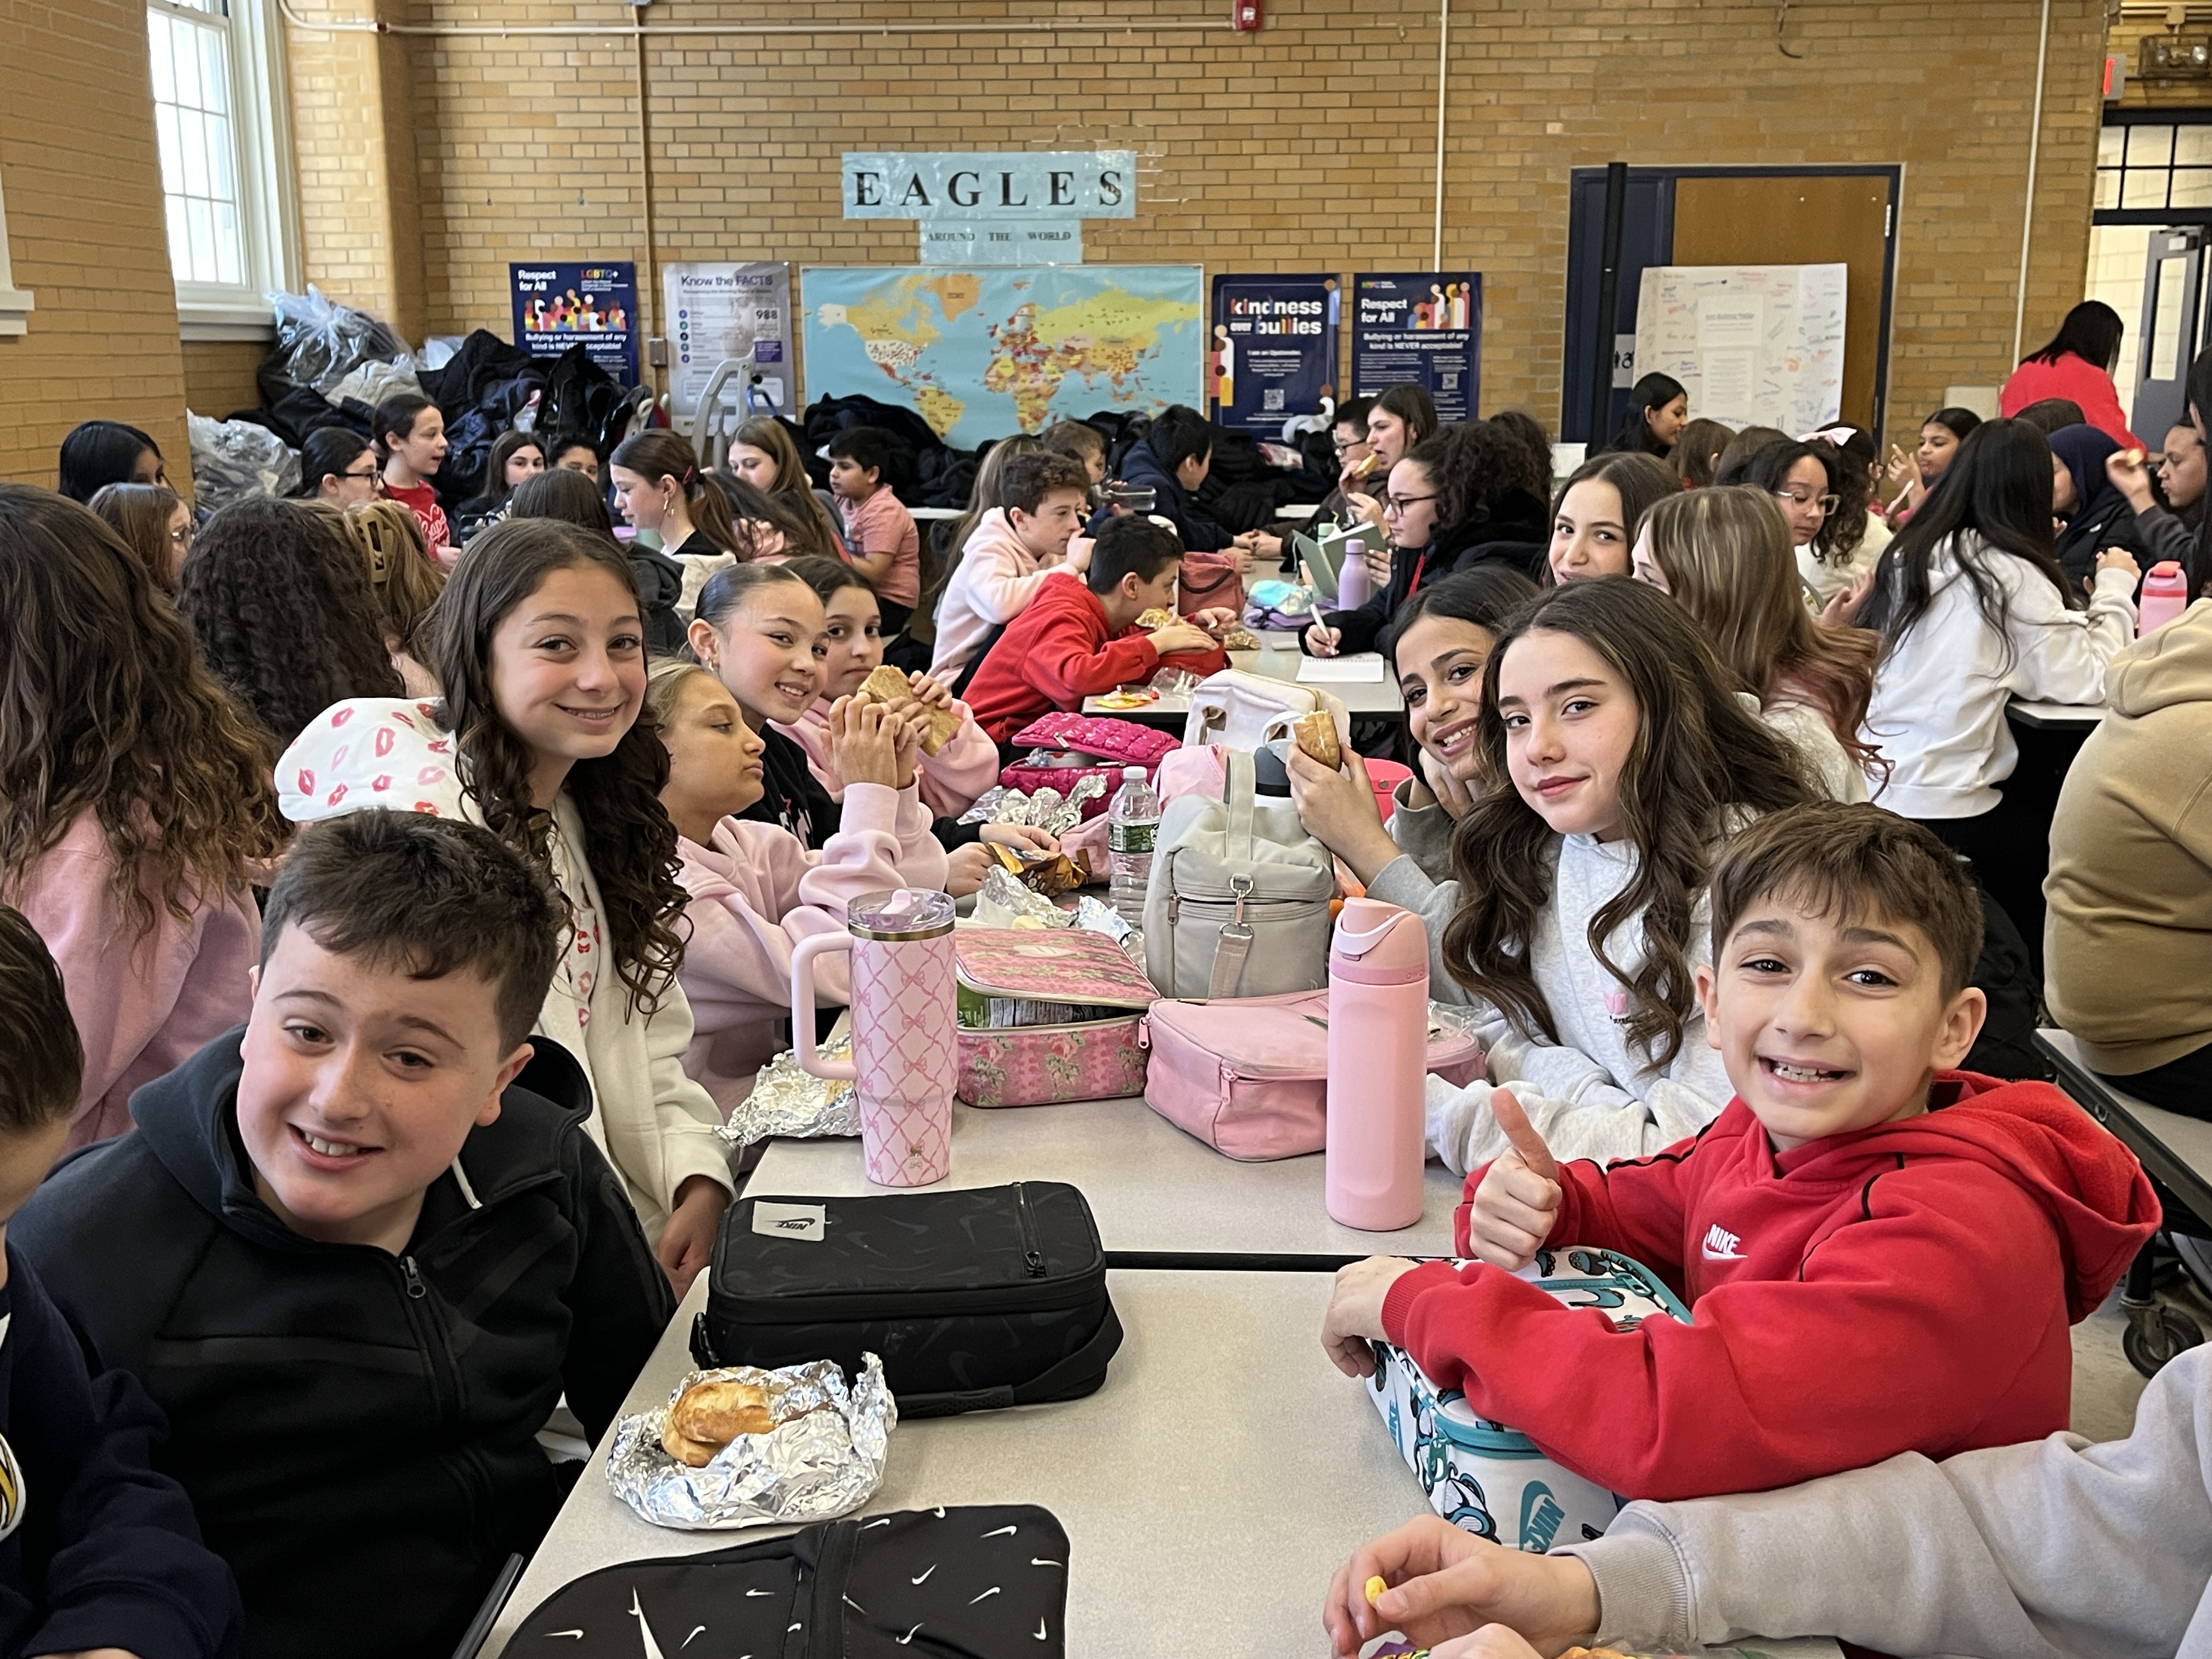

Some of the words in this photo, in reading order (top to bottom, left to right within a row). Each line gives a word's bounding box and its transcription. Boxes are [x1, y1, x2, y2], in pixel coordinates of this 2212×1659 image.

[853, 171, 1122, 207] EAGLES
[928, 232, 975, 241] AROUND
[989, 232, 1012, 241] THE
[1027, 232, 1071, 241] WORLD
[518, 269, 556, 281] Respect
[681, 275, 713, 286] Know
[715, 276, 733, 286] the
[736, 275, 774, 286] FACTS
[519, 281, 533, 291] for
[534, 281, 548, 291] All
[1230, 298, 1323, 315] kindness
[1361, 298, 1407, 311] Respect
[756, 309, 778, 320] 988
[1361, 312, 1378, 323] for
[1379, 312, 1395, 323] All
[1255, 317, 1322, 335] bullies
[1363, 332, 1392, 341] Bullying
[1394, 342, 1420, 350] NEVER
[775, 1222, 809, 1231] NIKE
[1707, 1223, 1741, 1256] NIKE
